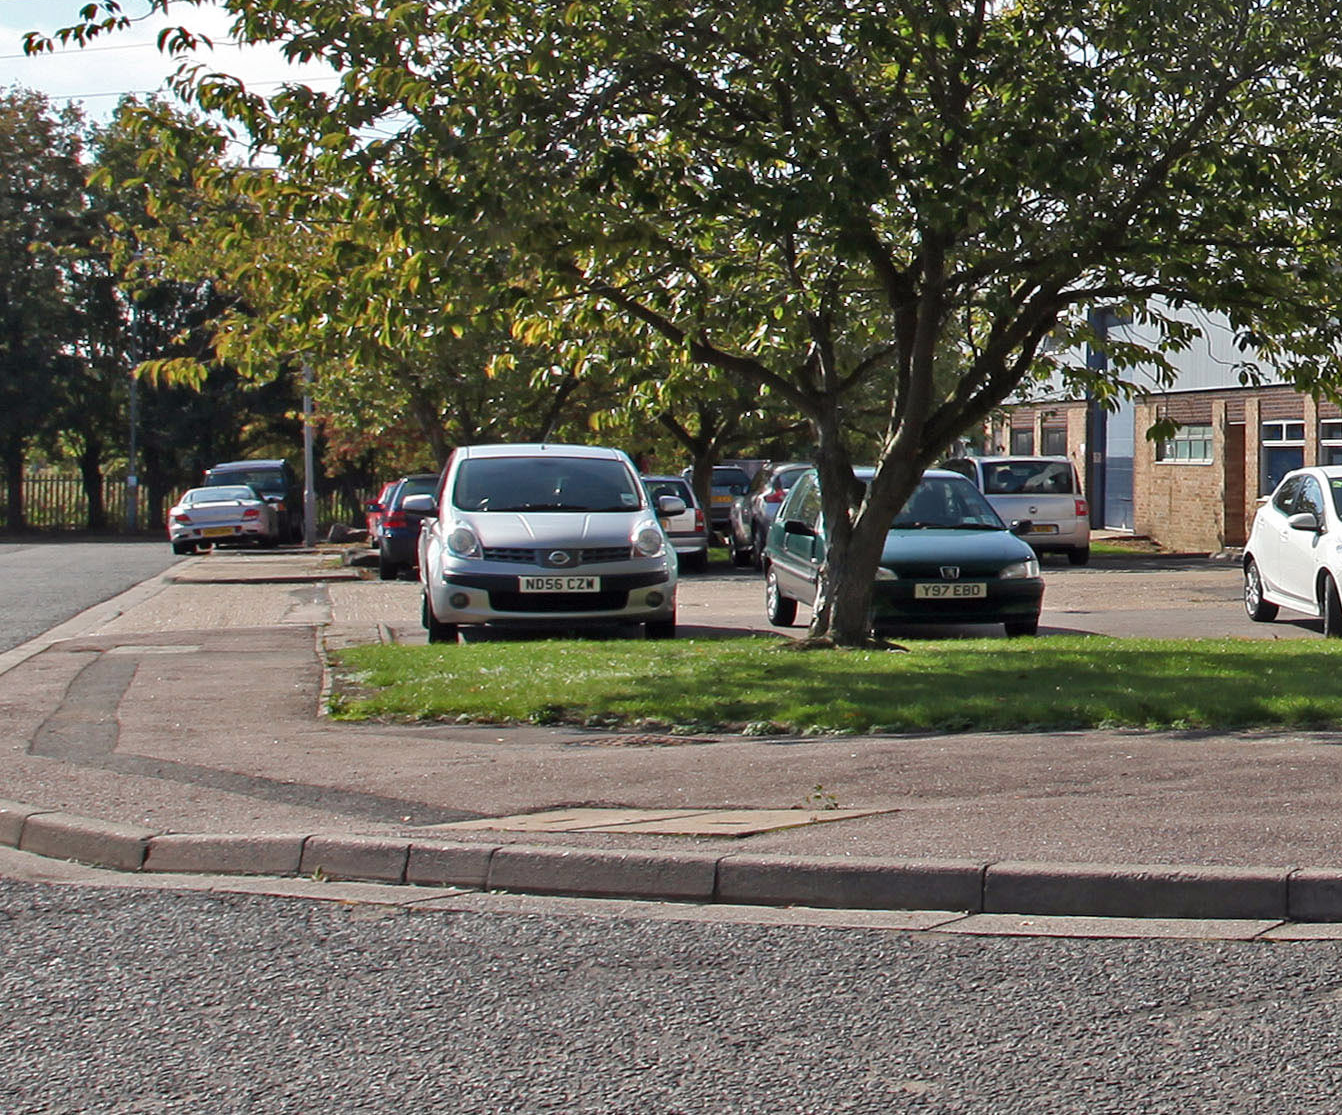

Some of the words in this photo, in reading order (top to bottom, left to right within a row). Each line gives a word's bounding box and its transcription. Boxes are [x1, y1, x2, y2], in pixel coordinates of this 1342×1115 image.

[526, 579, 563, 590] ND56
[567, 579, 594, 590] CZW
[923, 585, 950, 596] Y97
